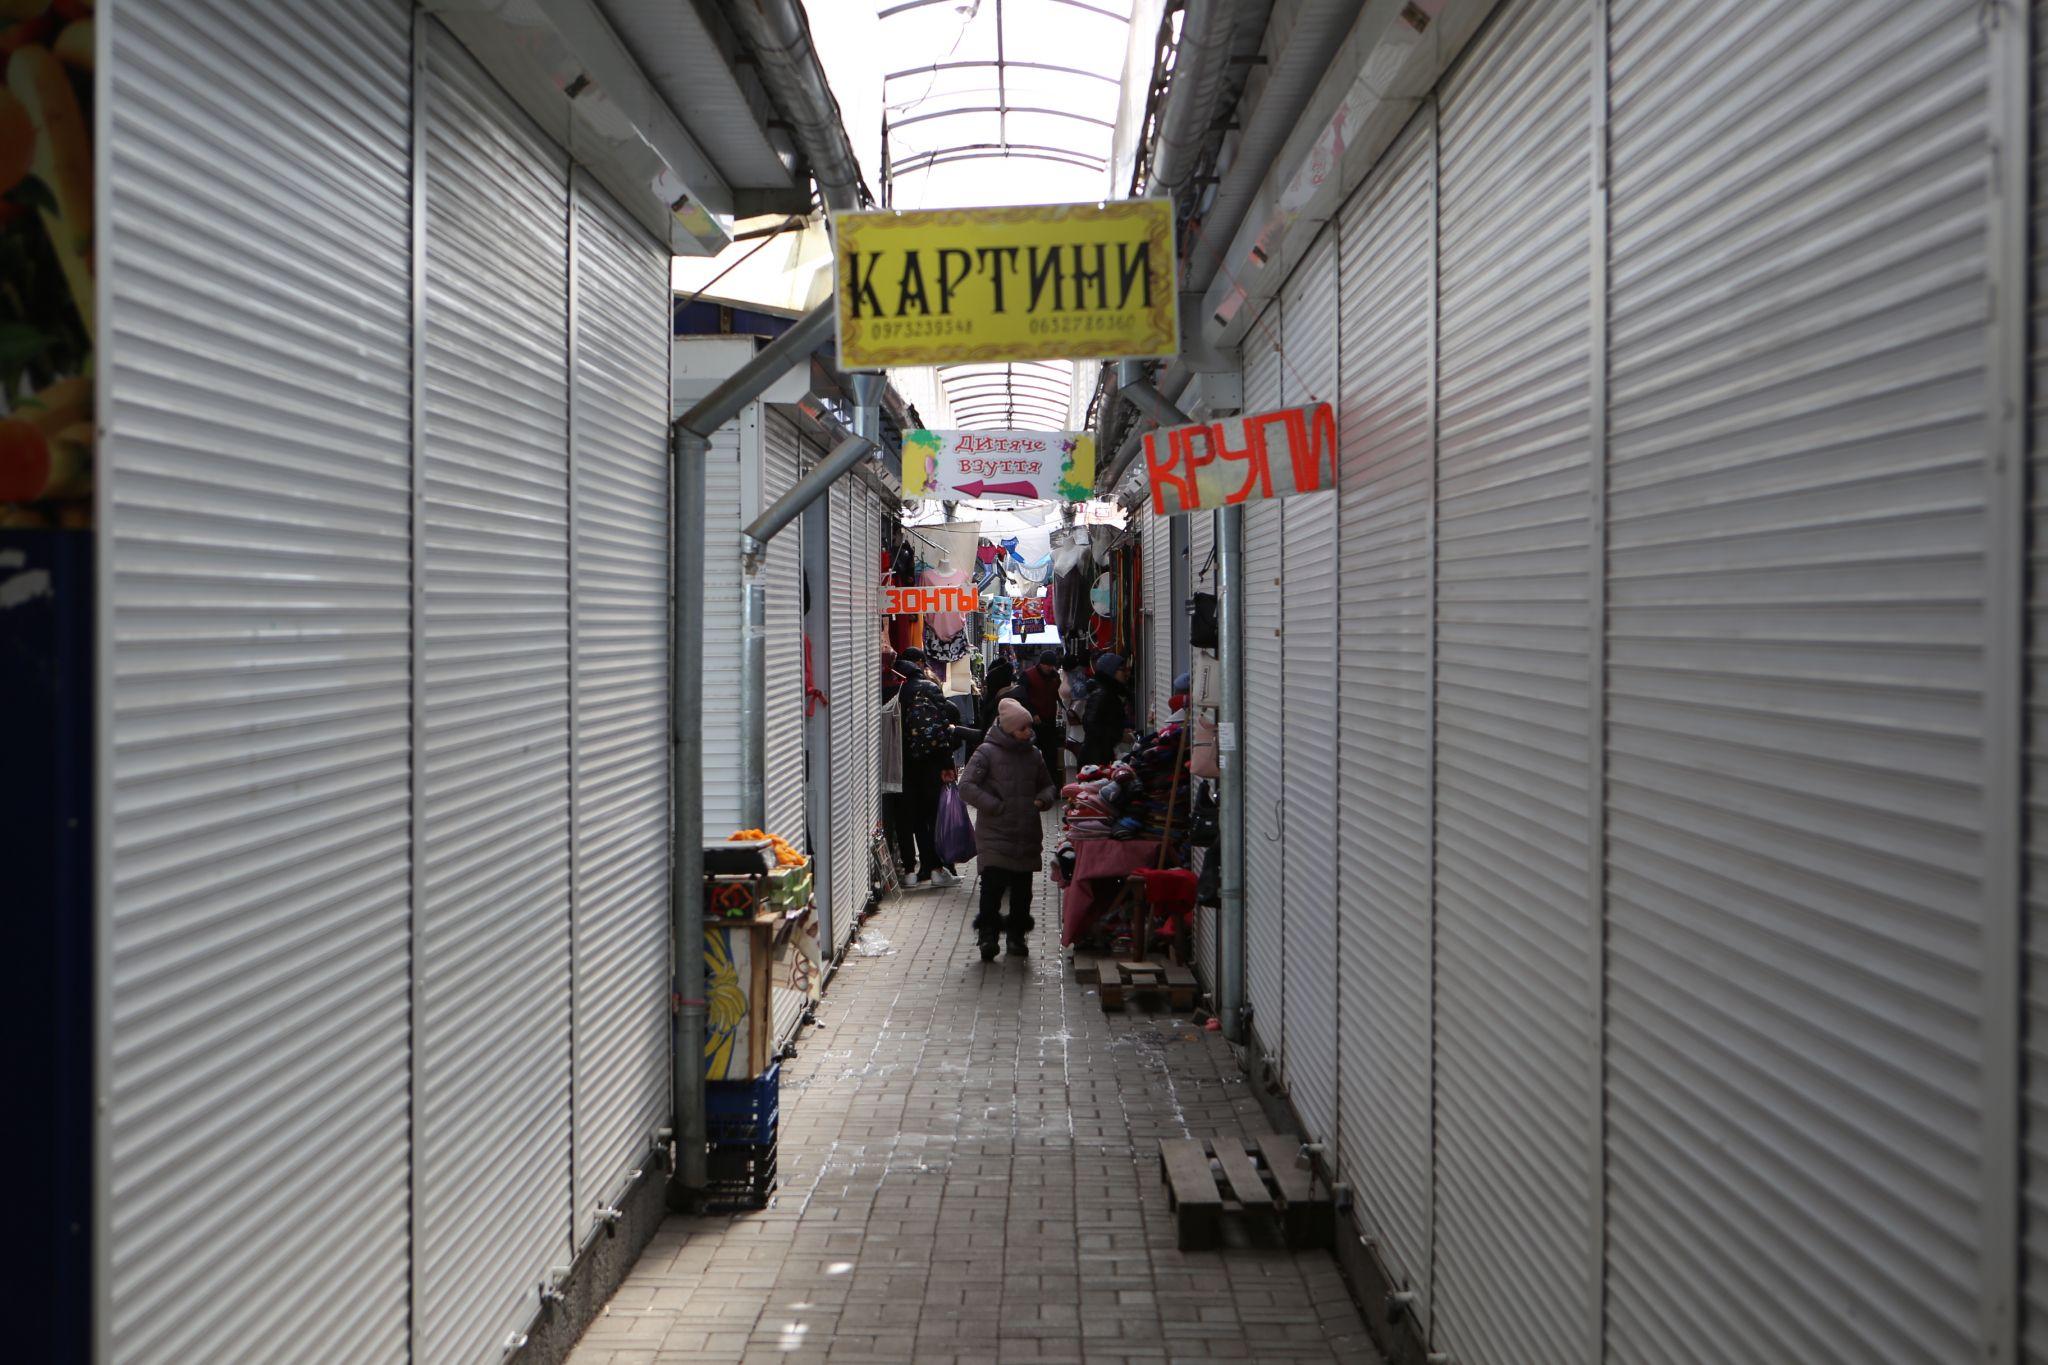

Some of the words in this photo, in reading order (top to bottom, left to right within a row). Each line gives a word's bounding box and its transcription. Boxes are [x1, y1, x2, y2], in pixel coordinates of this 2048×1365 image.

[848, 242, 1155, 318] КАРТИНИ
[953, 433, 1046, 454] Дитяче
[1144, 402, 1336, 515] КРУПИ
[886, 588, 978, 613] ЗОНТЫ
